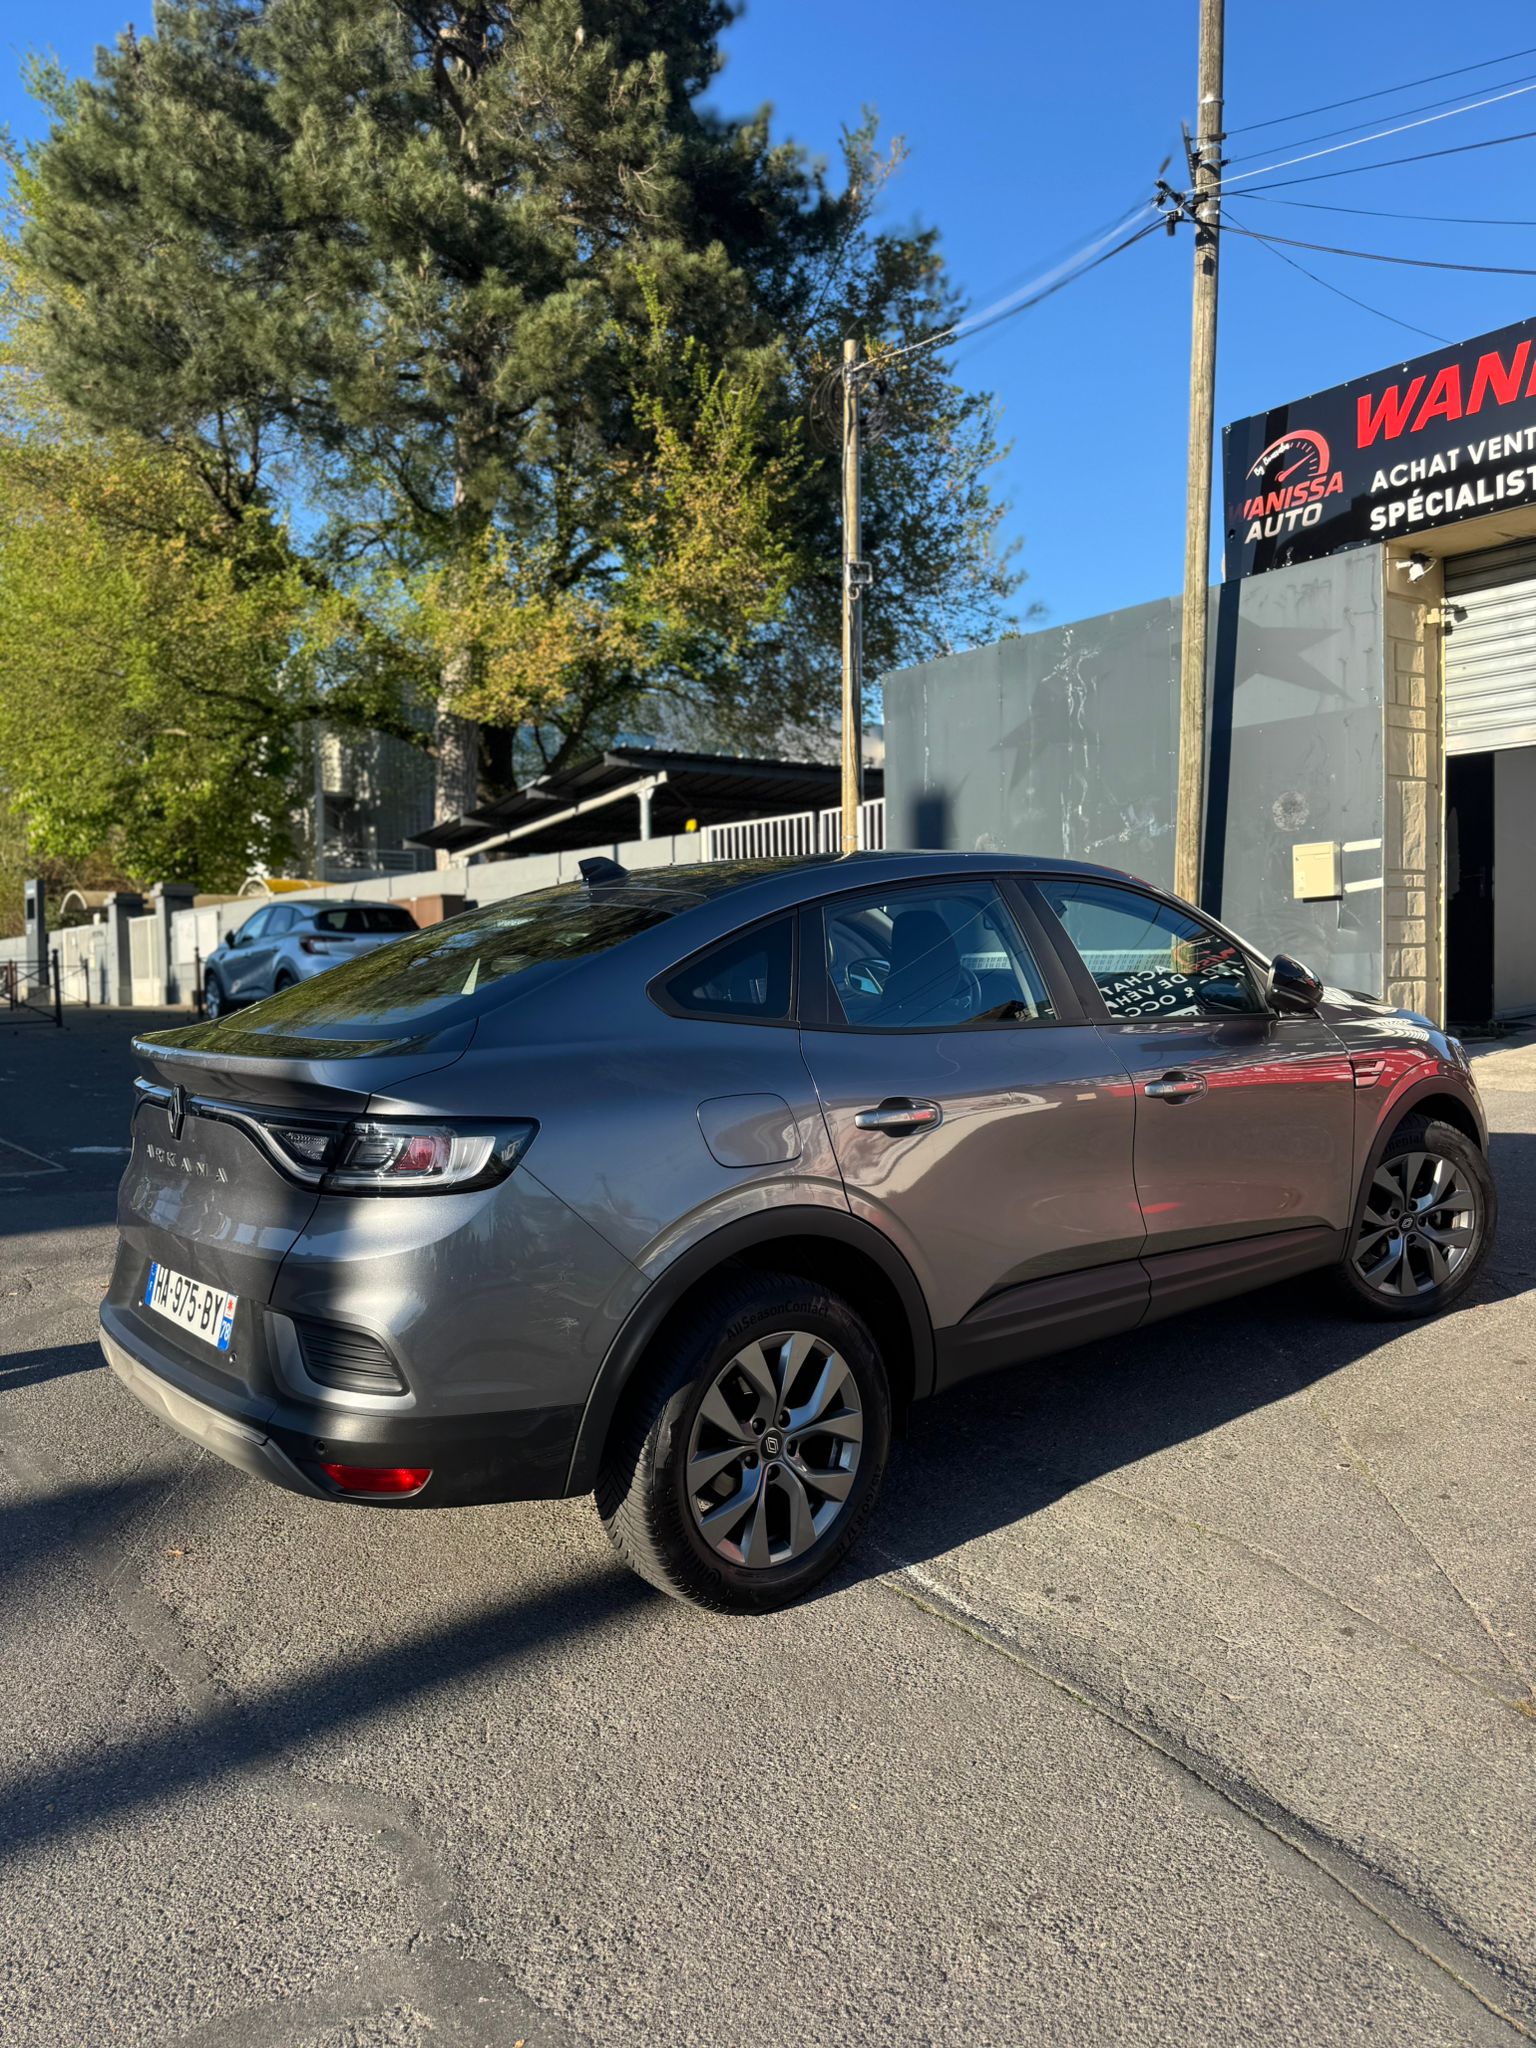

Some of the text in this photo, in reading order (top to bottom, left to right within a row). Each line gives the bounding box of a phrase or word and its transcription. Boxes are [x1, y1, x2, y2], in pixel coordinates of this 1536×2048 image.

[1357, 340, 1536, 449] WAN
[1370, 448, 1460, 493] ACHAT
[1244, 502, 1323, 545] AUTO
[147, 1144, 229, 1183] ARKANA
[153, 1266, 224, 1335] HA-975-BY
[726, 1299, 830, 1340] AllSeasonContact
[220, 1320, 232, 1342] 78
